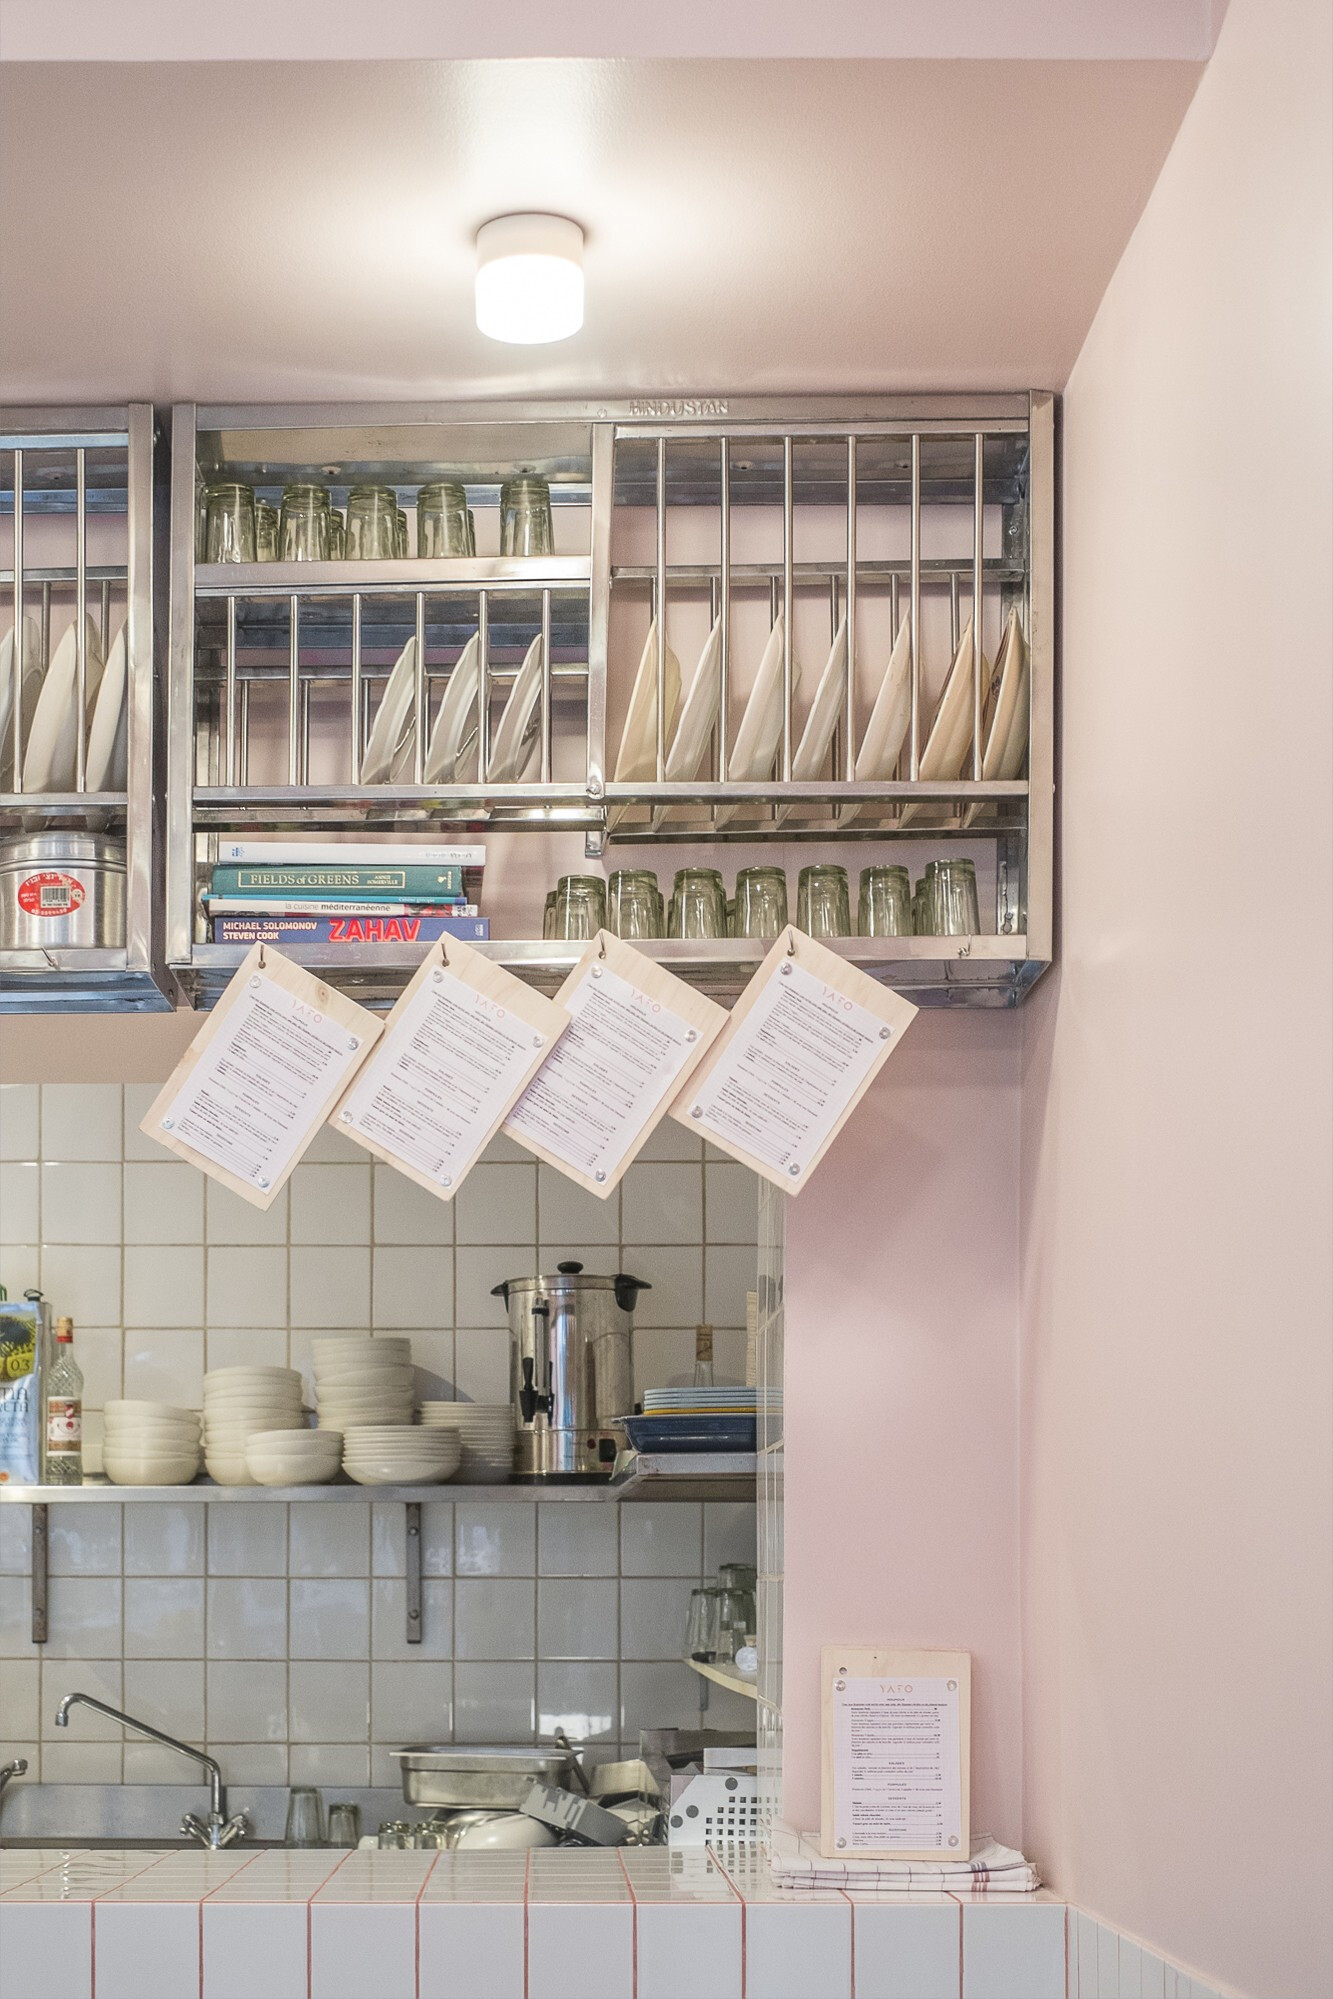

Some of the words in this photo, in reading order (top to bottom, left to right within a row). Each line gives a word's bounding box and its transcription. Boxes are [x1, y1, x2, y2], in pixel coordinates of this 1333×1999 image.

[629, 400, 728, 416] HINDUSTAN
[250, 875, 295, 885] FIELDS
[296, 875, 307, 885] of
[307, 875, 360, 885] GREENS
[285, 902, 292, 910] la
[293, 902, 319, 910] cuisine
[320, 902, 391, 912] méditerranéenne
[222, 922, 261, 930] MICHAEL
[263, 922, 317, 930] SOLOMONOV
[328, 918, 421, 942] ZAHAV
[222, 932, 256, 940] STEVEN
[257, 932, 279, 940] COOK
[10, 1359, 30, 1372] 0.3
